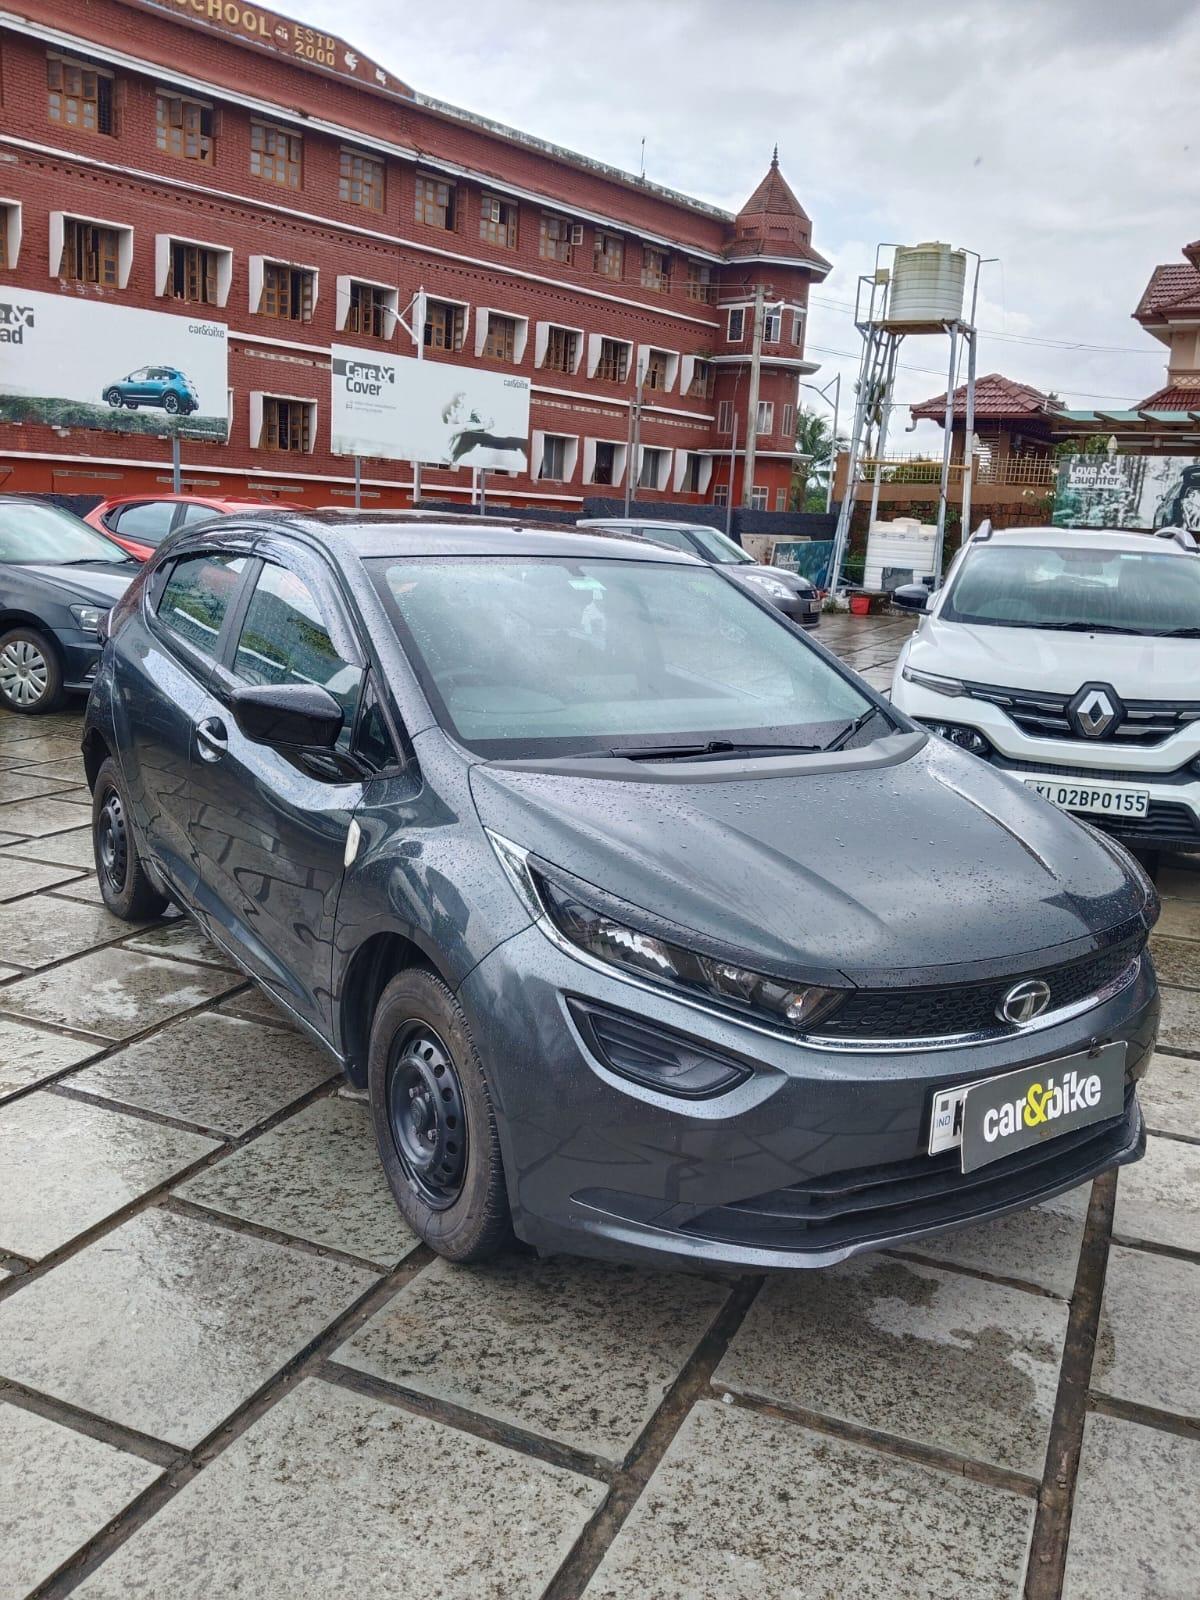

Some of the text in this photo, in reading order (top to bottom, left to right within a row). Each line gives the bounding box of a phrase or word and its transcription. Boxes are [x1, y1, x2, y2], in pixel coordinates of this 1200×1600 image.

[175, 0, 272, 38] CHOOL
[294, 24, 336, 50] ESTD
[294, 41, 336, 66] 2000
[345, 361, 395, 384] Care &
[345, 376, 383, 396] Cover
[1069, 461, 1117, 476] Love &
[1068, 474, 1120, 487] Laughter
[983, 1071, 1101, 1143] car&bike
[936, 1115, 951, 1128] IND
